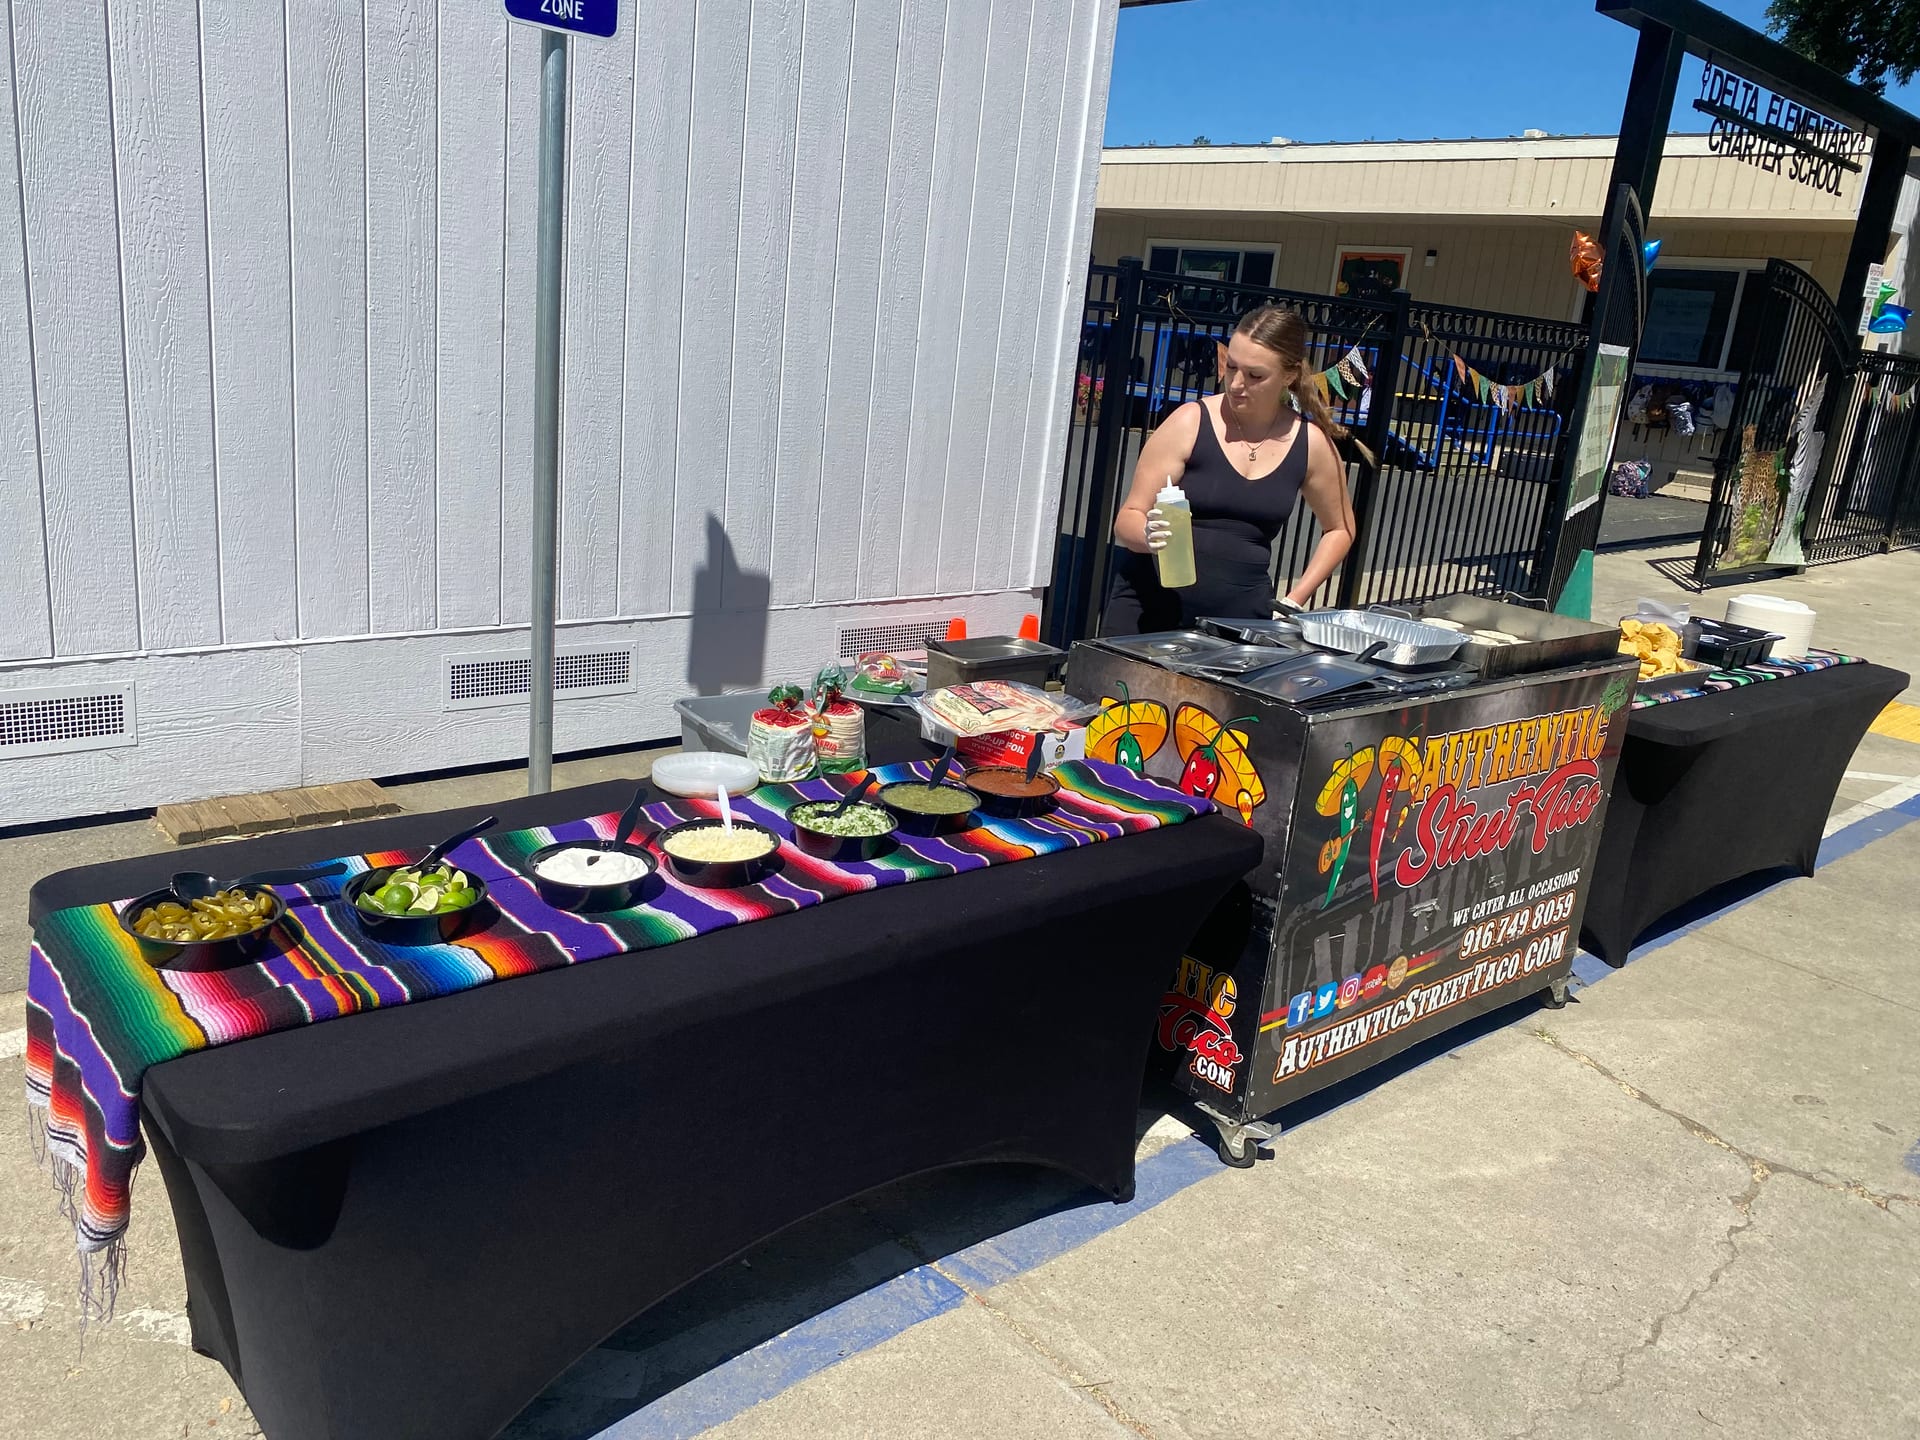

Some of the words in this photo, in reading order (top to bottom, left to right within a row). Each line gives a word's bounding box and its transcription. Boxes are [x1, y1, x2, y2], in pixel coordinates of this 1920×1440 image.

[541, 0, 584, 20] ZONE
[1708, 68, 1759, 119] DELTA
[1765, 94, 1859, 160] ELEMENTARY
[1708, 118, 1785, 175] CHARTER
[1788, 152, 1843, 196] SCHOOL
[1005, 741, 1025, 755] FOIL
[1414, 704, 1610, 803] AUTHENTIC
[1395, 781, 1535, 888] Street
[1530, 759, 1603, 854] Taco
[1453, 908, 1471, 927] WE
[1472, 895, 1506, 920] CATER
[1506, 888, 1526, 908] ALL
[1527, 868, 1581, 900] OCCASIONS
[1460, 891, 1575, 959] 916.749.8059
[1158, 992, 1244, 1066] Taco
